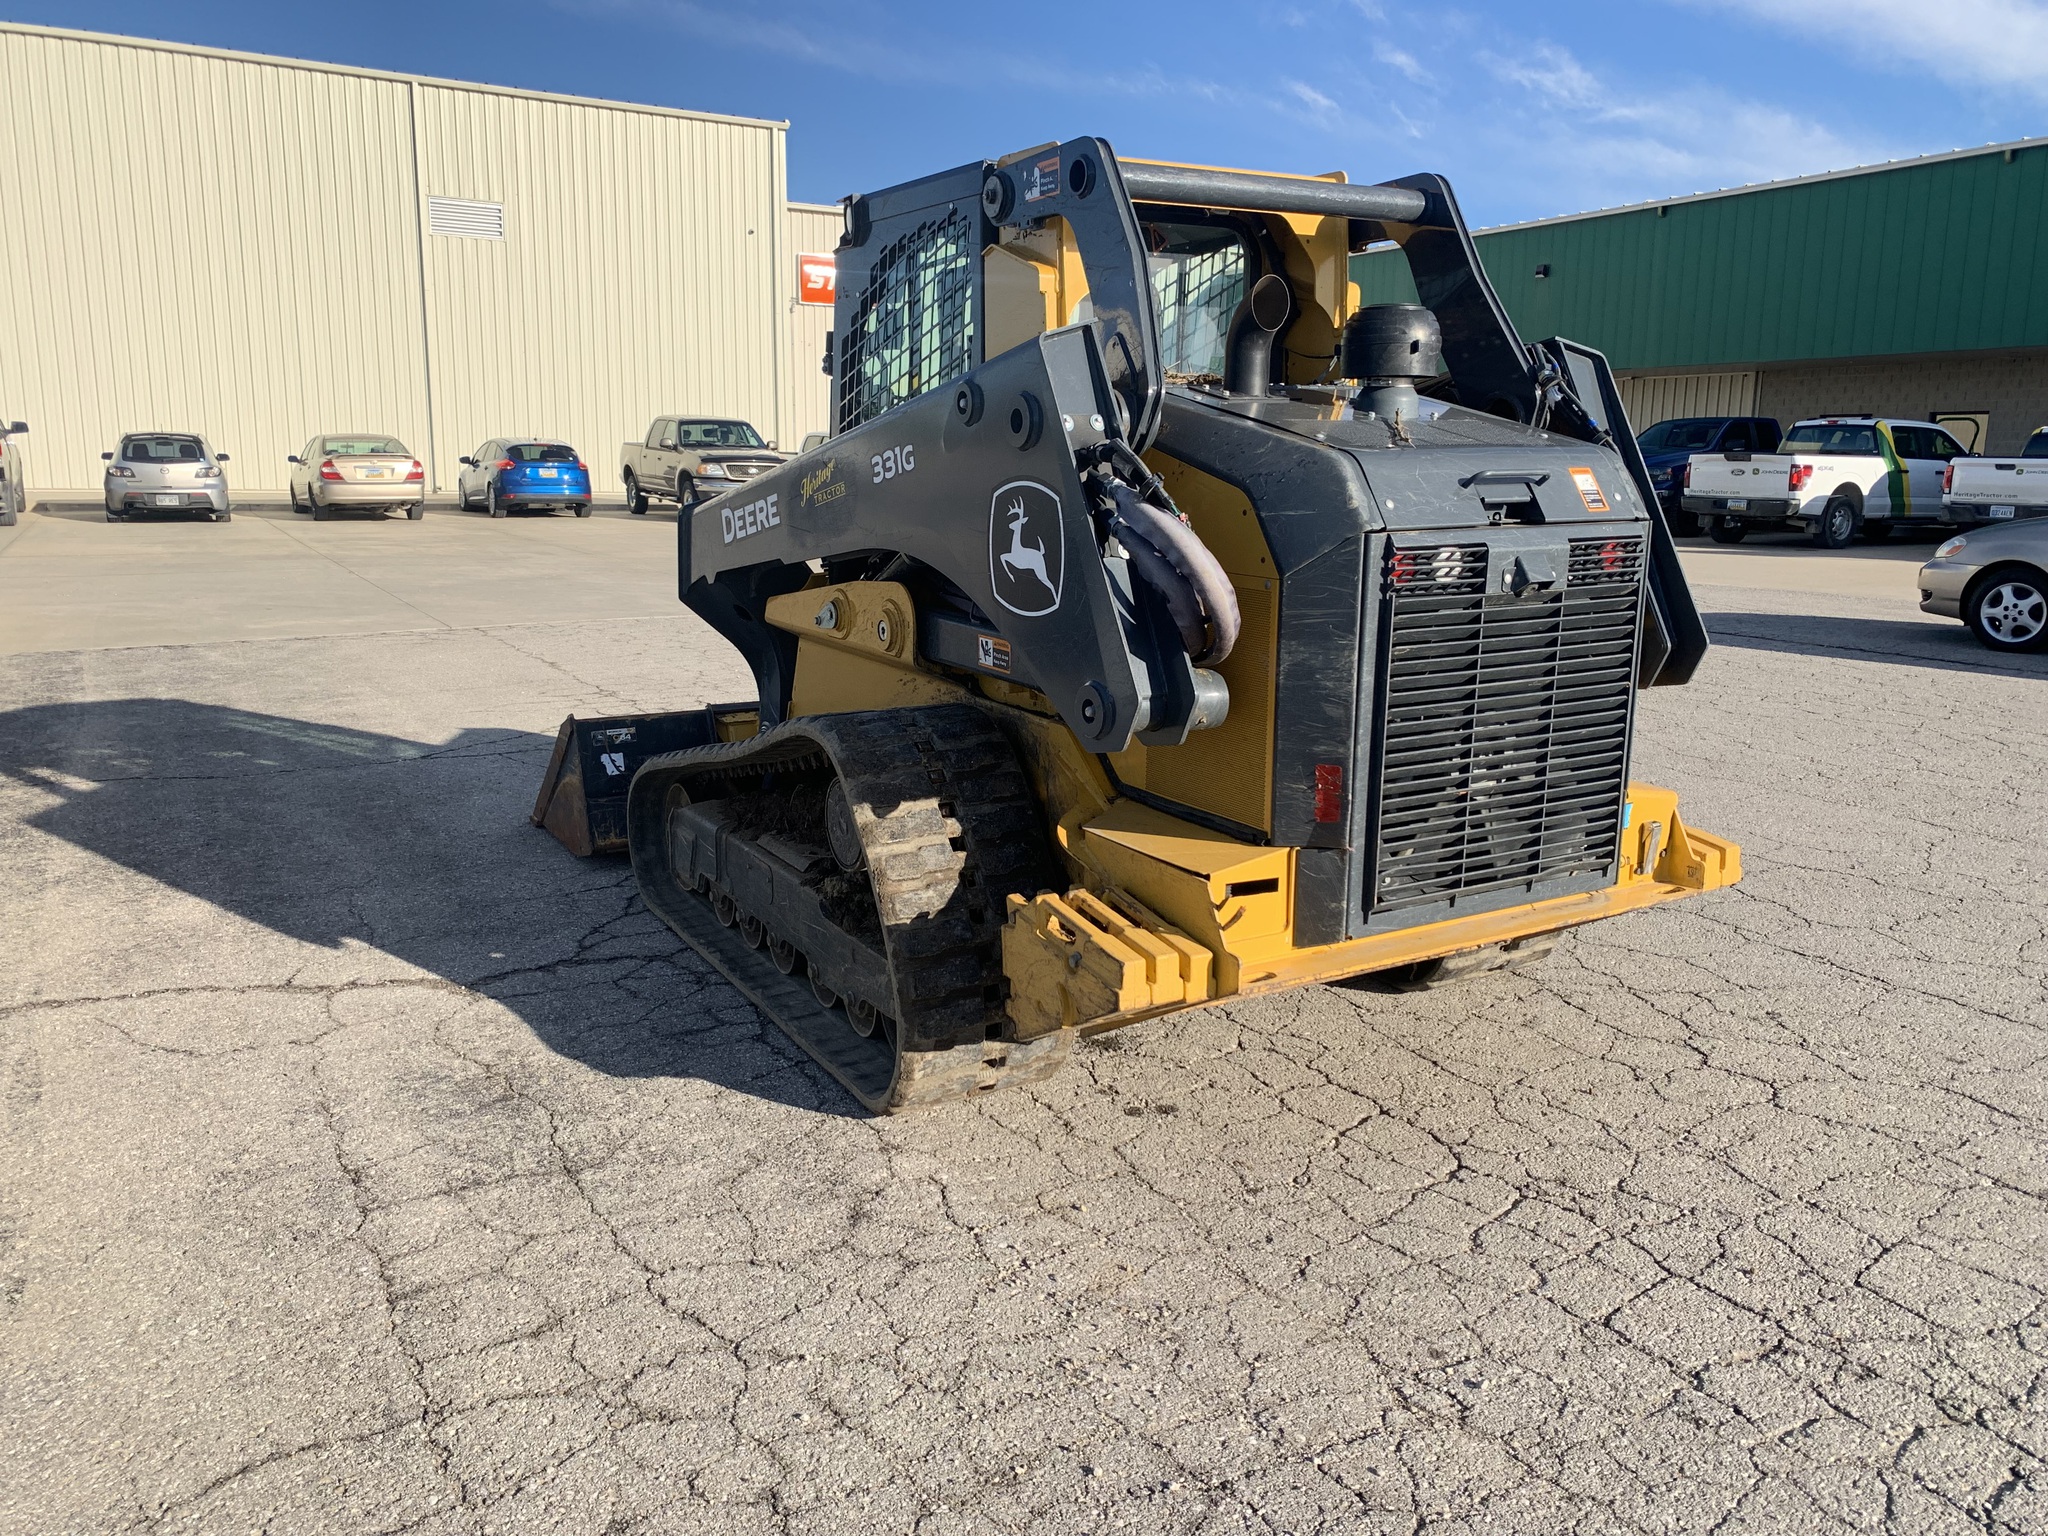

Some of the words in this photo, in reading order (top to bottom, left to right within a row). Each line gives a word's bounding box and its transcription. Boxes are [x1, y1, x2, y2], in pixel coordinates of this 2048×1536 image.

[800, 458, 838, 507] Heritage
[871, 445, 915, 483] 331G
[814, 483, 846, 504] TRACTOR
[1953, 491, 2018, 499] HeritageTractor.com
[720, 493, 781, 544] DEERE
